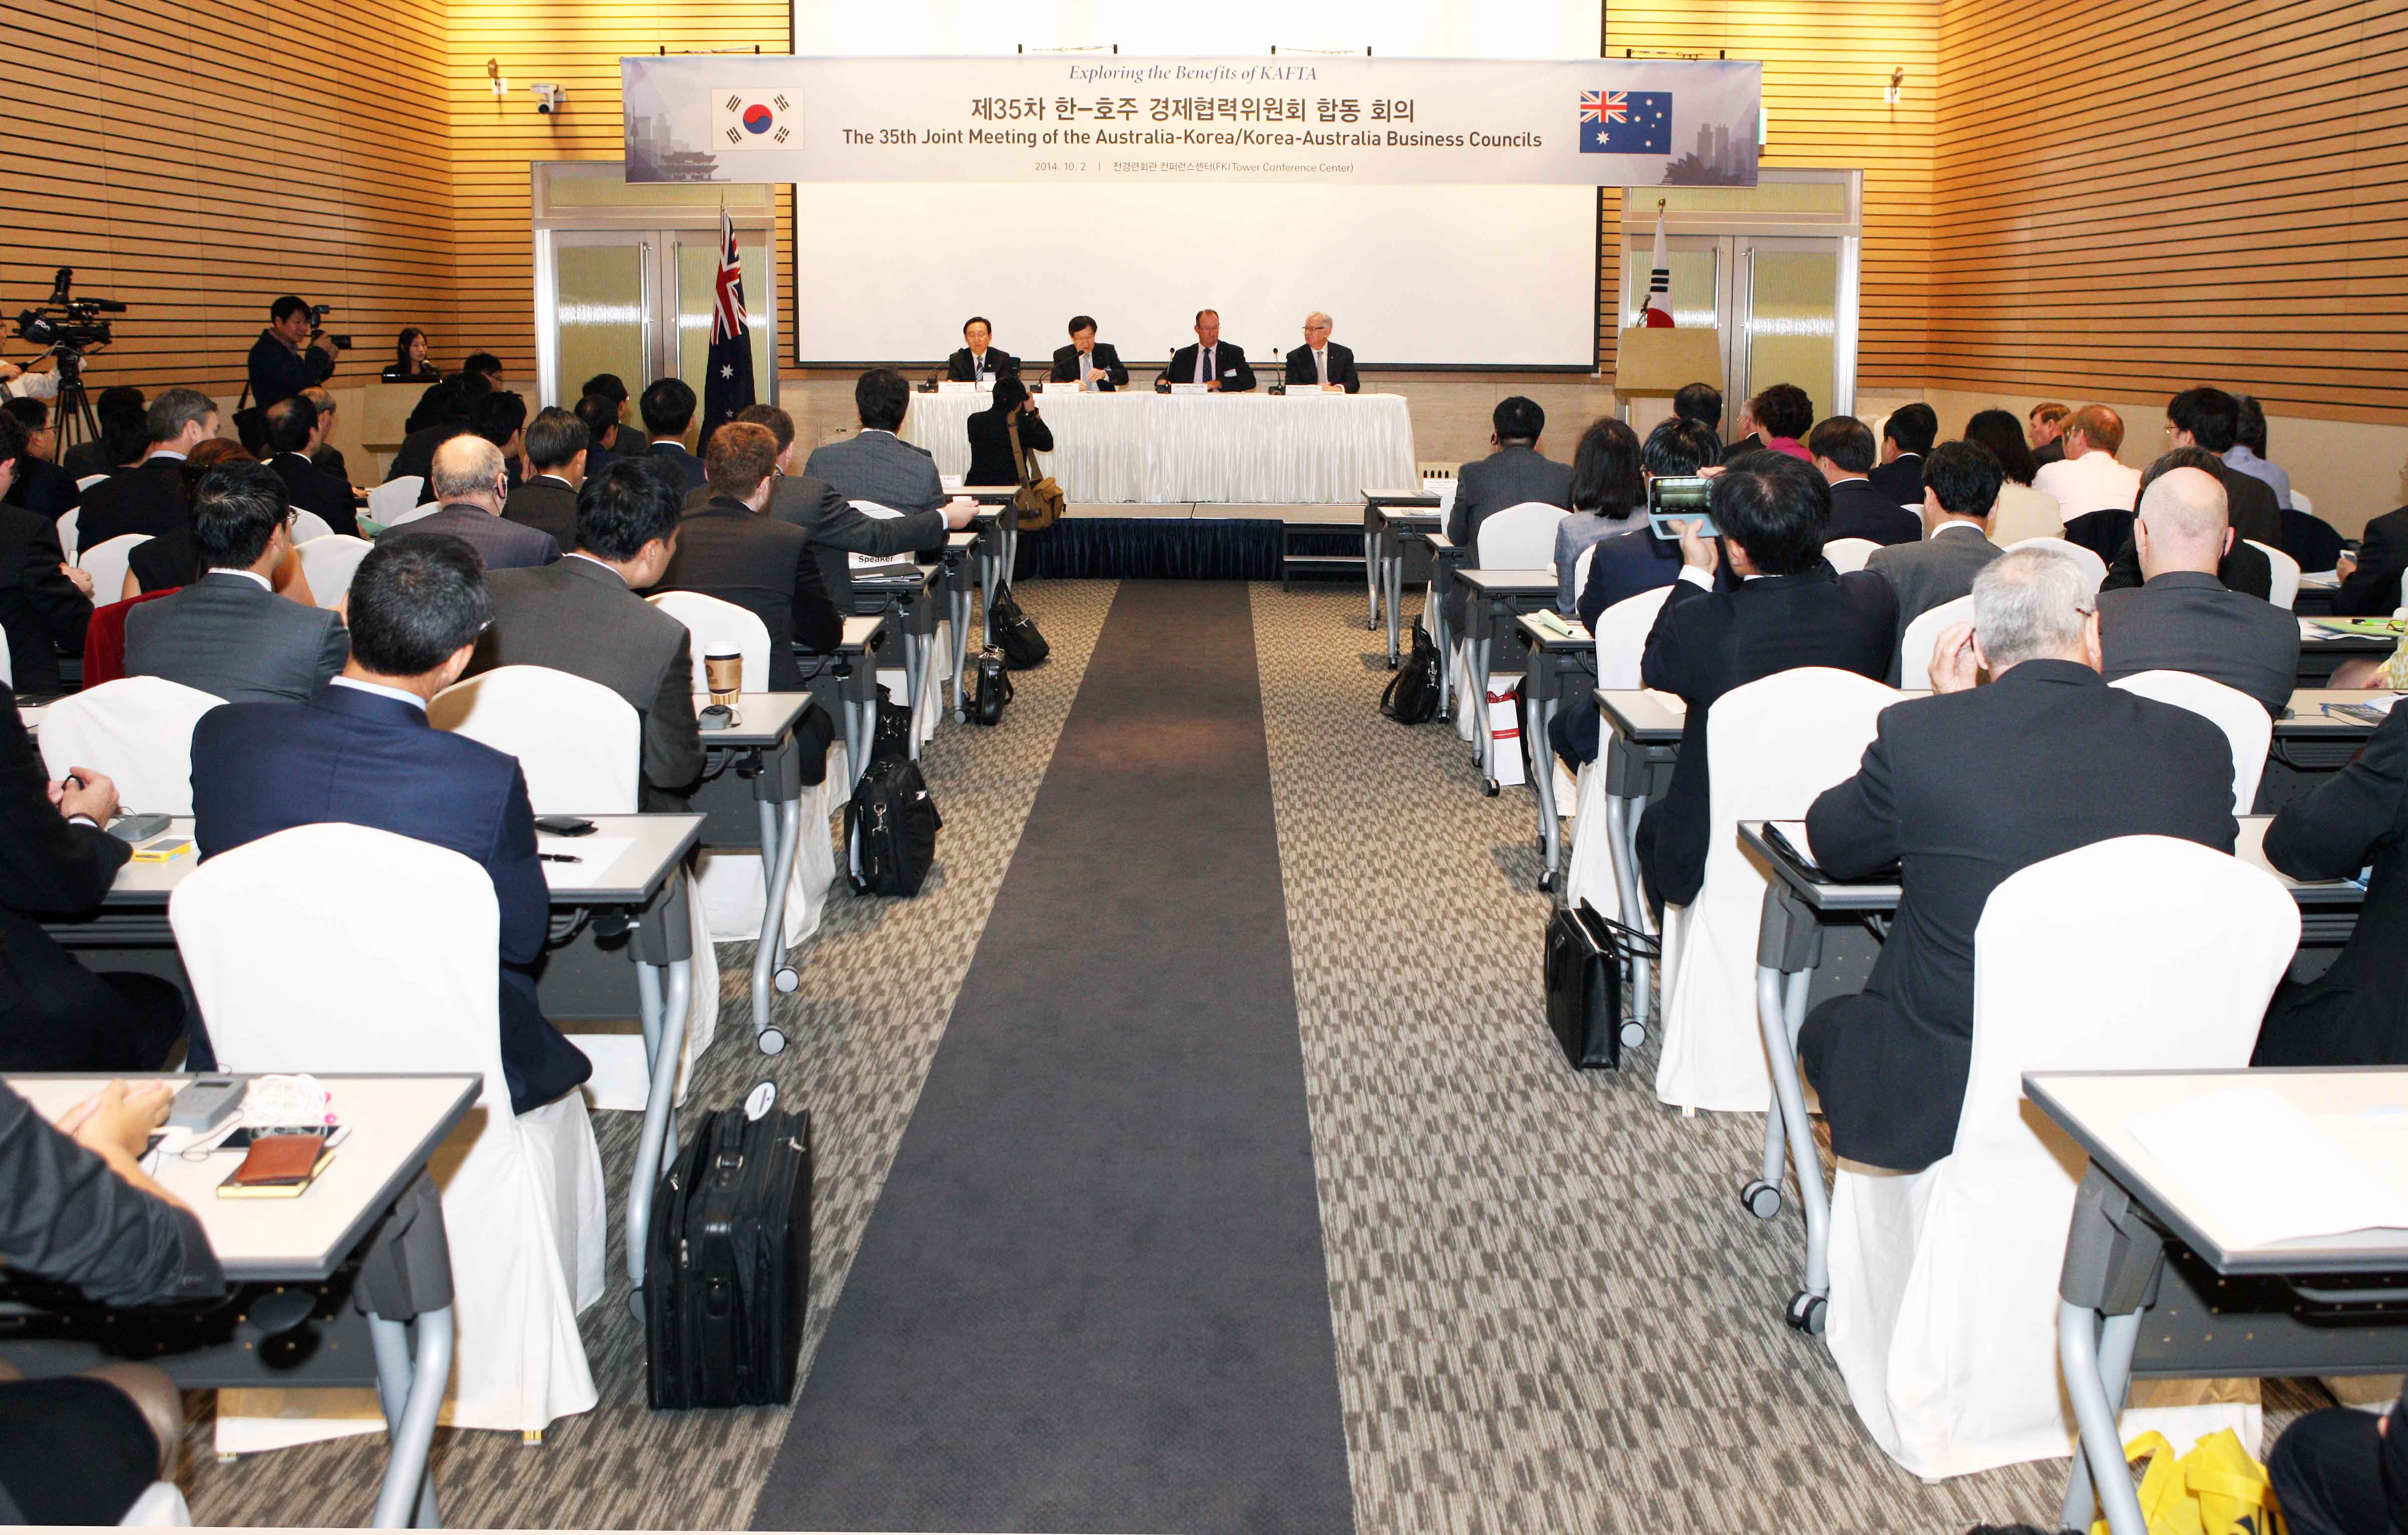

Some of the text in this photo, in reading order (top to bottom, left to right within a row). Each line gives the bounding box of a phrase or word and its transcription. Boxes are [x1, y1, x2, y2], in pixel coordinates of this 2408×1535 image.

[1069, 65, 1316, 84] Exploring the Benefits of KAFTA
[971, 97, 1046, 121] 제35차
[1149, 97, 1305, 122] 경제협력위원회
[1316, 98, 1361, 123] 합동
[1370, 99, 1414, 123] 회의
[842, 128, 1542, 148] The 35th Joint Meeting of the Australia-Korea/Korea-Australia Business Councils
[1081, 162, 1086, 171] 2
[1113, 162, 1158, 172] 전경련회관
[1232, 162, 1260, 172] Tower
[1262, 162, 1317, 173] Conference
[1319, 162, 1353, 173] Center)
